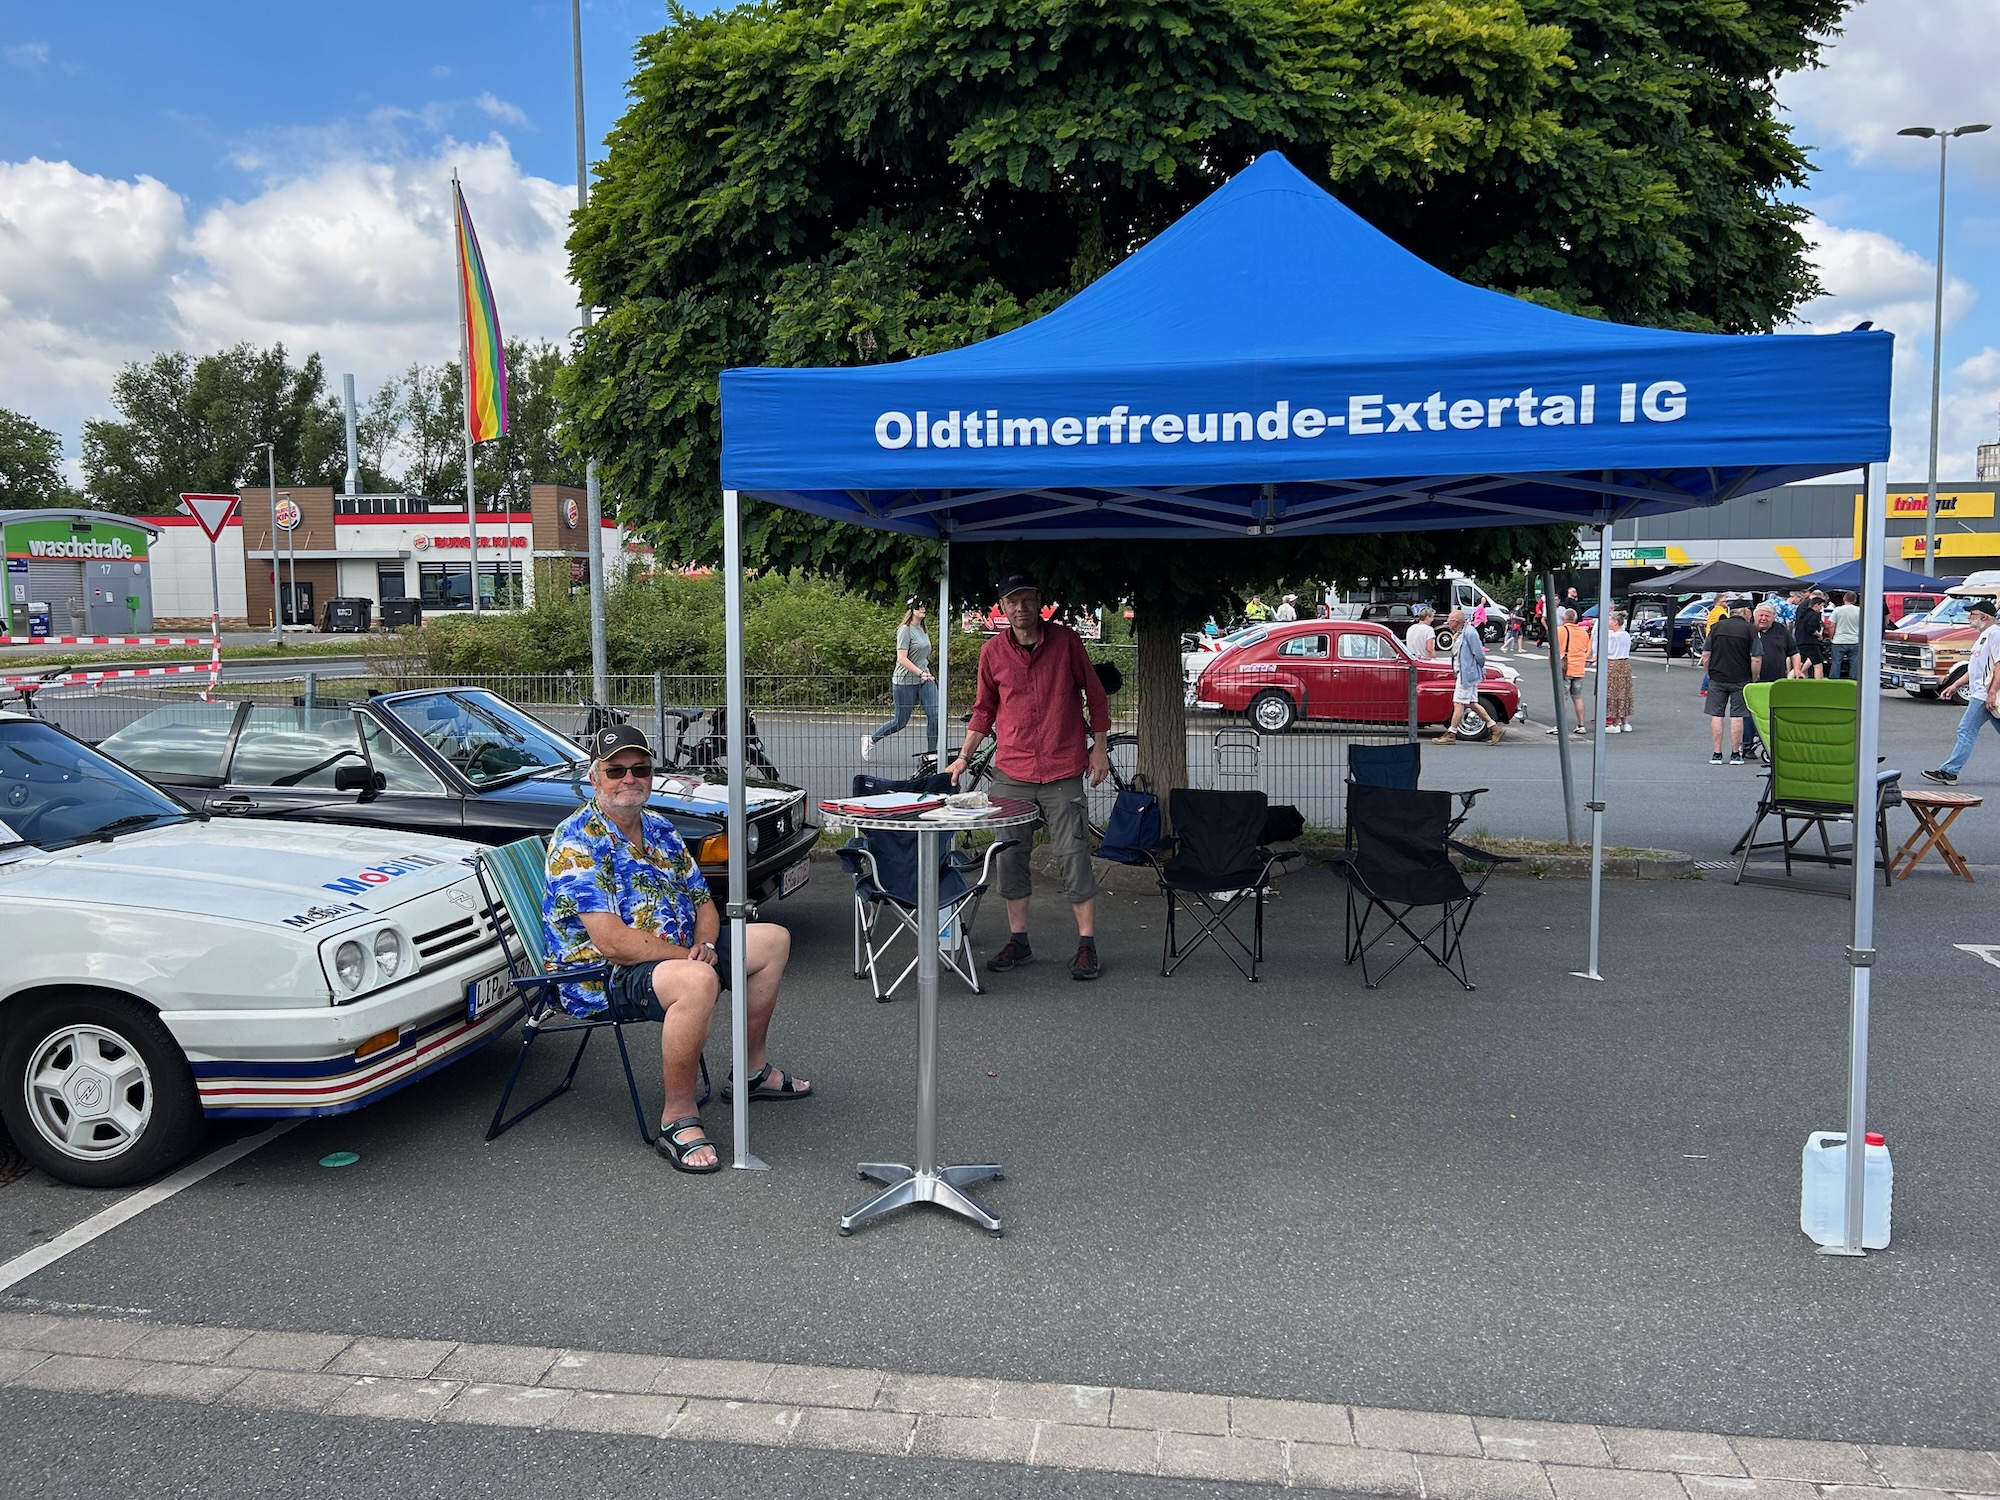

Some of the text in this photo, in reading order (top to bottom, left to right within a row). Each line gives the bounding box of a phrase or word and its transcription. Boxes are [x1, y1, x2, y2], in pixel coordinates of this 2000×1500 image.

[874, 380, 1688, 450] Oldtimerfreunde-Extertal IG
[28, 535, 132, 559] waschstraße
[492, 536, 527, 548] KING
[100, 564, 112, 575] 17
[321, 859, 423, 897] Mobil
[281, 904, 353, 928] Mbil
[477, 975, 499, 1008] LIP
